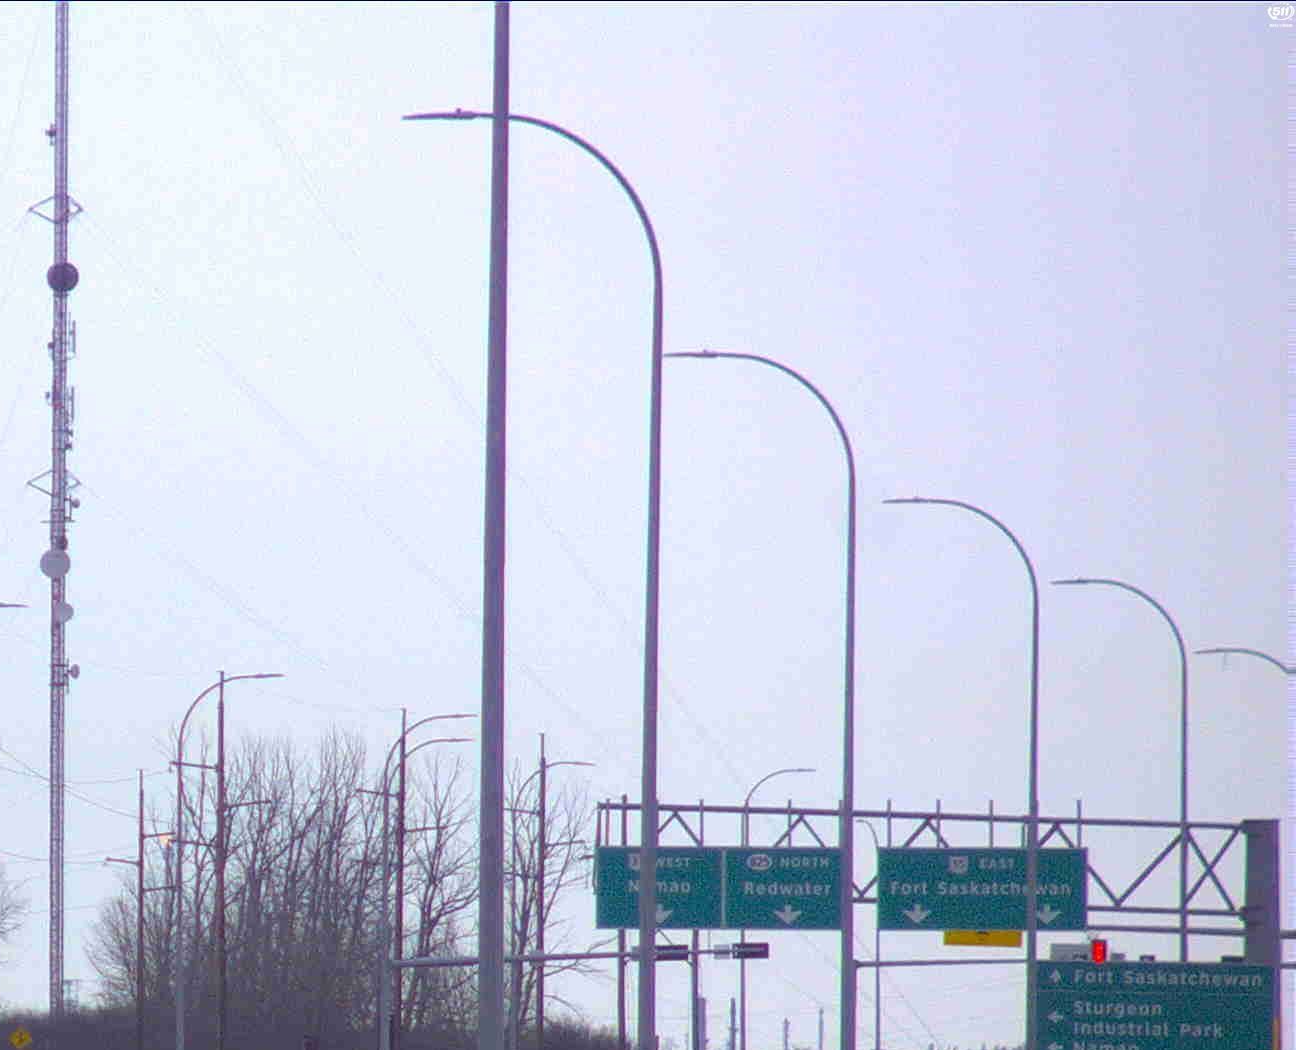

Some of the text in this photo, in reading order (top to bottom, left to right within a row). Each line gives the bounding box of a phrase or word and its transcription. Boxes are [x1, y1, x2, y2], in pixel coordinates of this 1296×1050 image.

[779, 857, 830, 868] NORTH
[977, 858, 1015, 870] EAST
[628, 880, 691, 894] Nmao
[743, 882, 832, 896] Redwater
[890, 881, 929, 895] Fort
[1073, 969, 1263, 987] Fort Saskatchewan
[1073, 1001, 1162, 1018] Sturgeon
[1073, 1022, 1223, 1038] Industrial Park
